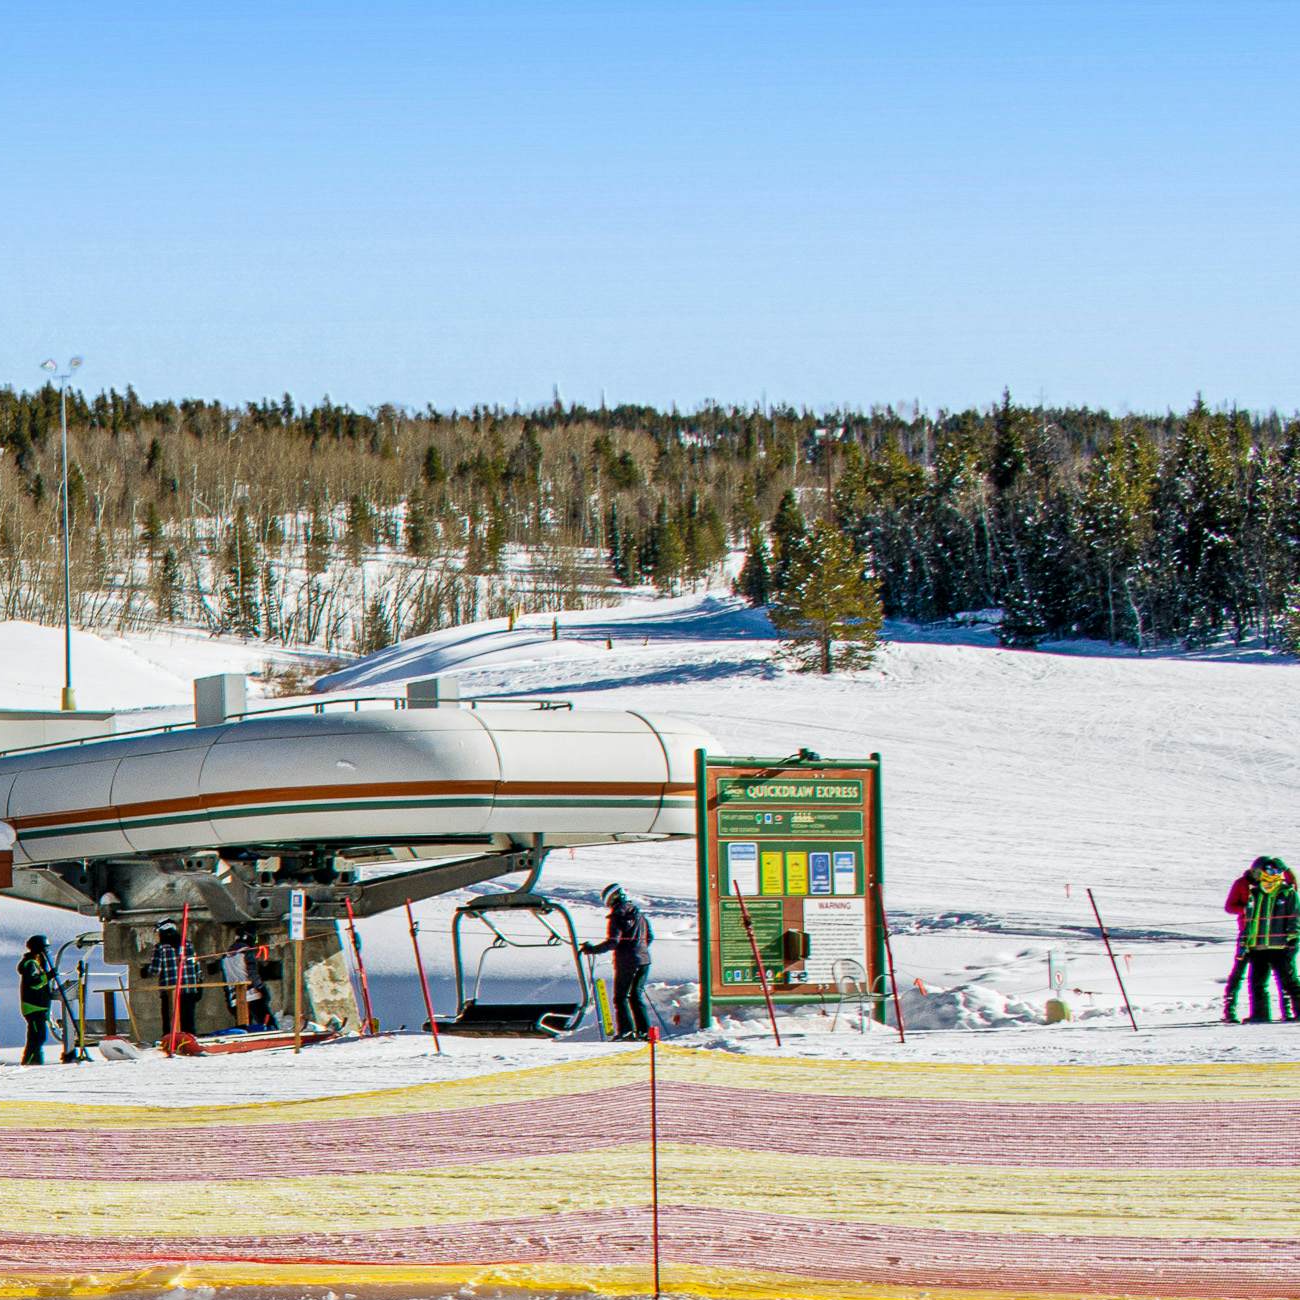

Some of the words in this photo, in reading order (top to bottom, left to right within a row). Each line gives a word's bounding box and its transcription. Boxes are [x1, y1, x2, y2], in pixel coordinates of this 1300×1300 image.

[746, 785, 814, 798] QUICKDRAW
[816, 785, 858, 798] EXPRESS
[818, 902, 851, 910] WARNING
